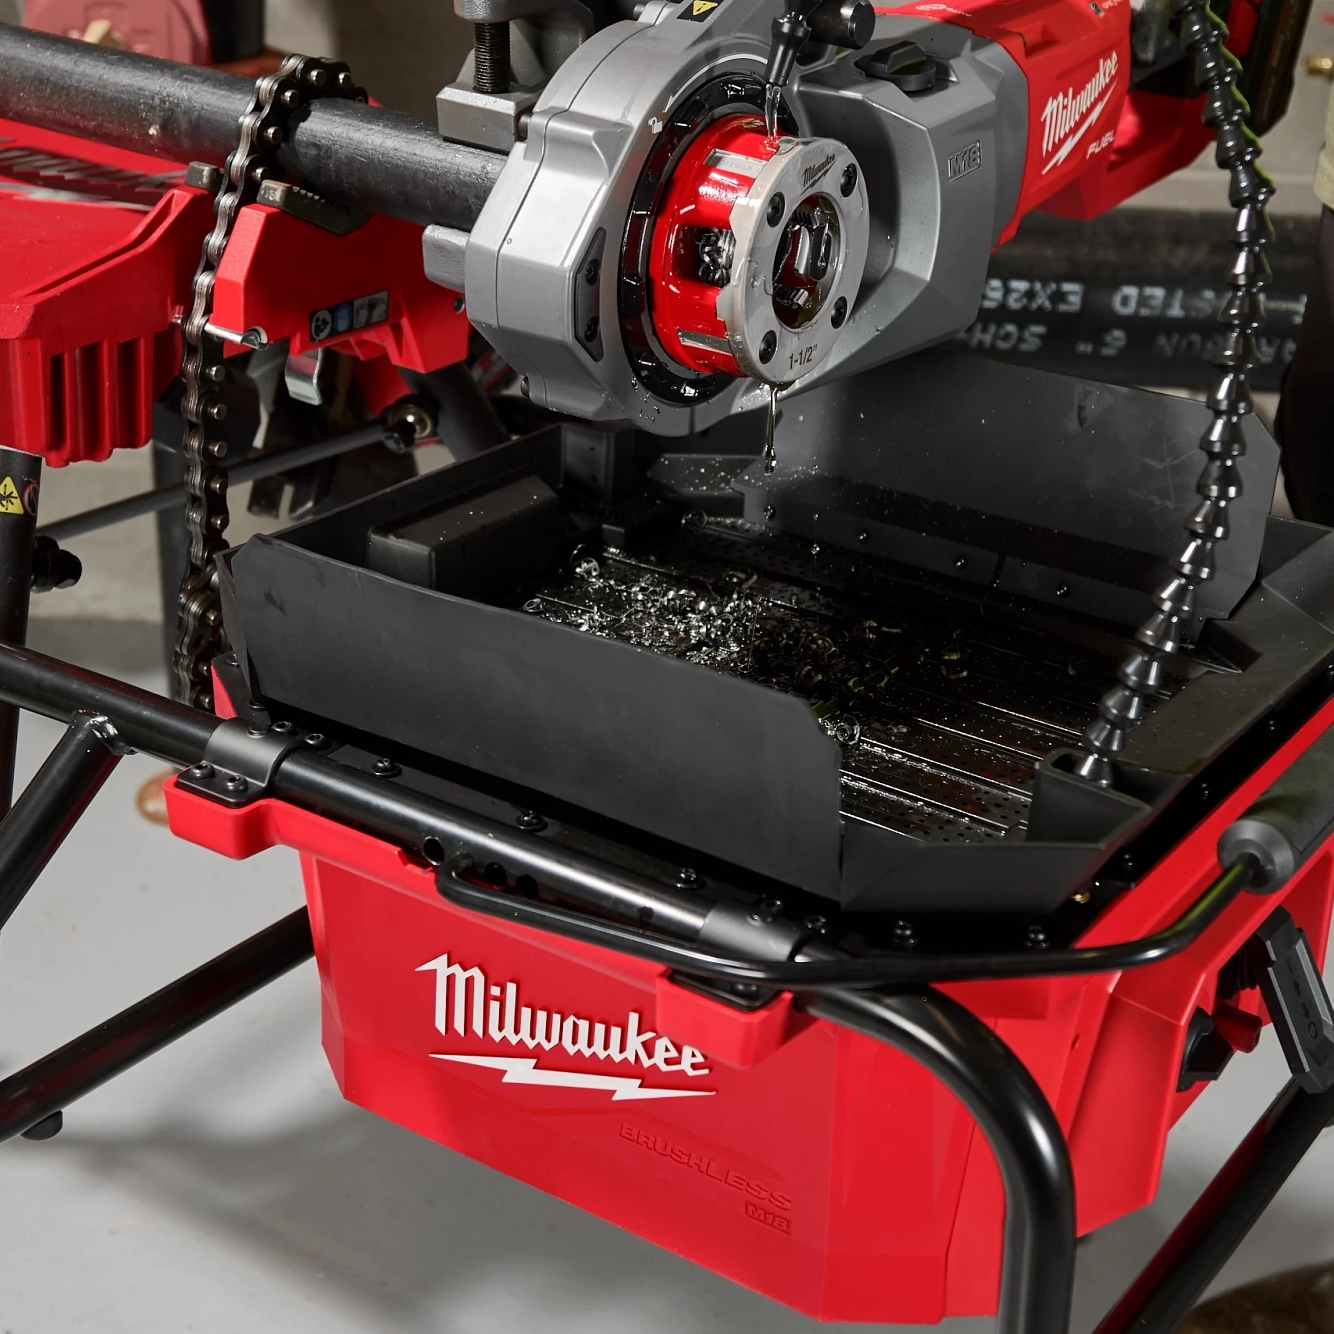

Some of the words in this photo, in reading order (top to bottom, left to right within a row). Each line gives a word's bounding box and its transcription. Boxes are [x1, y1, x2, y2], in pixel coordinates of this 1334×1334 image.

[1040, 51, 1119, 159] Milwaukee
[949, 142, 982, 179] M18
[1086, 130, 1115, 159] FUEL
[801, 153, 836, 188] Milwaukee
[789, 343, 818, 370] 1-1/2"
[415, 953, 709, 1076] Milwaukee
[620, 1123, 792, 1211] BRUSHLESS
[748, 1201, 790, 1233] M18
